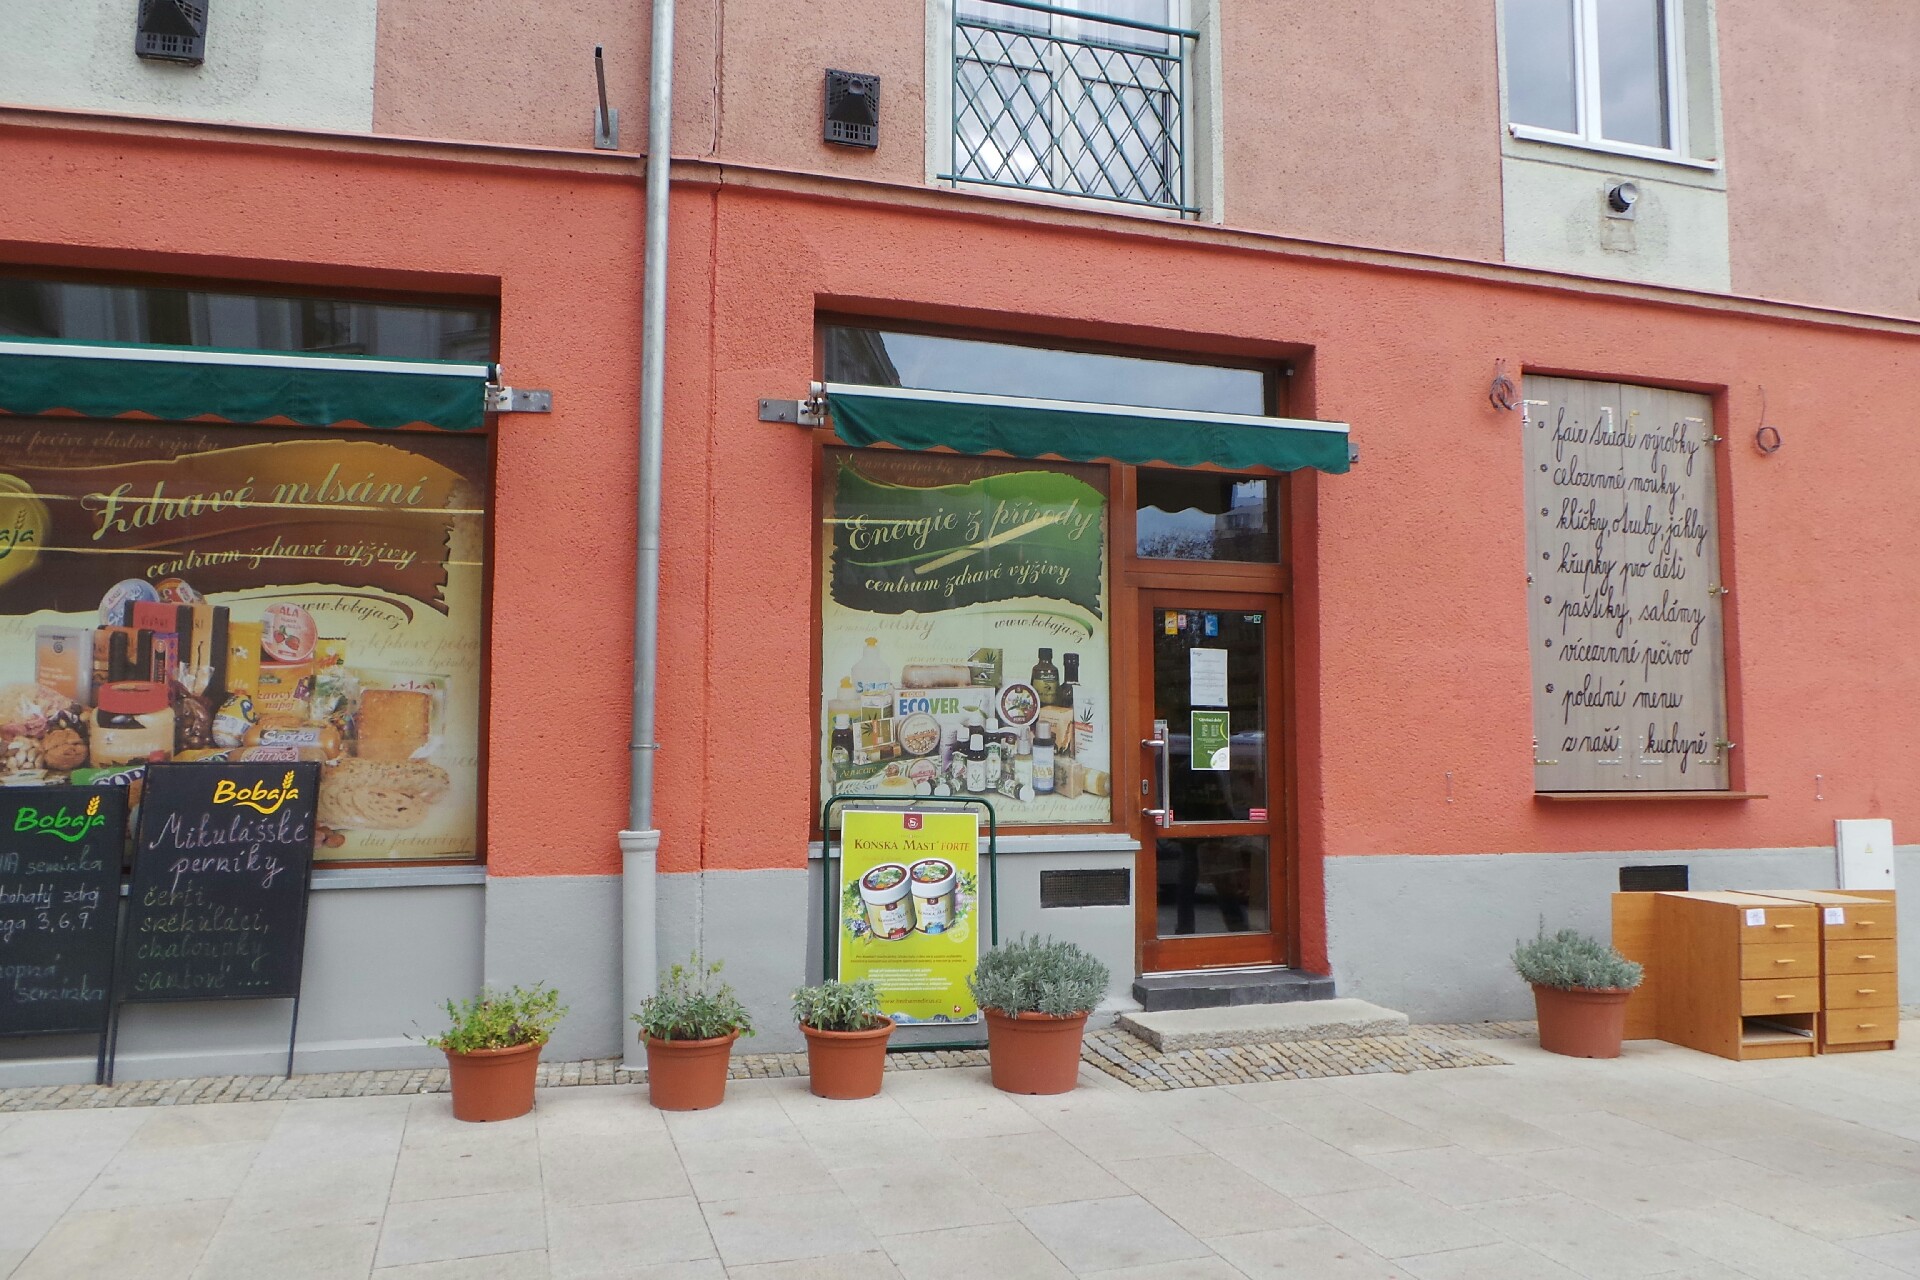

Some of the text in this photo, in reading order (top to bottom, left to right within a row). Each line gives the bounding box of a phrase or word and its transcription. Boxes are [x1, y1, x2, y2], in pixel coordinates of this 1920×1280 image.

[1552, 406, 1589, 462] fair
[1639, 422, 1699, 477] výrobky
[80, 463, 428, 541] Zdravé mlsání
[1553, 454, 1685, 516] celozrnné mouky,
[844, 498, 1094, 550] Energie z přírody
[1663, 507, 1708, 557] jáhly
[146, 535, 417, 579] centrum zdravé výživy
[865, 559, 1071, 598] centrum zdravé výživy
[1557, 542, 1686, 596] křupky pro děti
[994, 614, 1087, 644] www.bobaja.cz
[1558, 585, 1706, 646] paštiky, salámy
[1559, 637, 1694, 683] vícezrnné pečivo
[899, 698, 960, 716] ECOVER
[1562, 673, 1683, 725] polední menu
[1562, 722, 1708, 774] z naší kuchyně
[213, 771, 299, 815] Bobaja
[14, 796, 105, 842] Bobaja
[150, 808, 313, 850] Mikulášské
[169, 843, 284, 892] perníky
[941, 841, 971, 852] FORTE
[63, 882, 99, 909] zdroj
